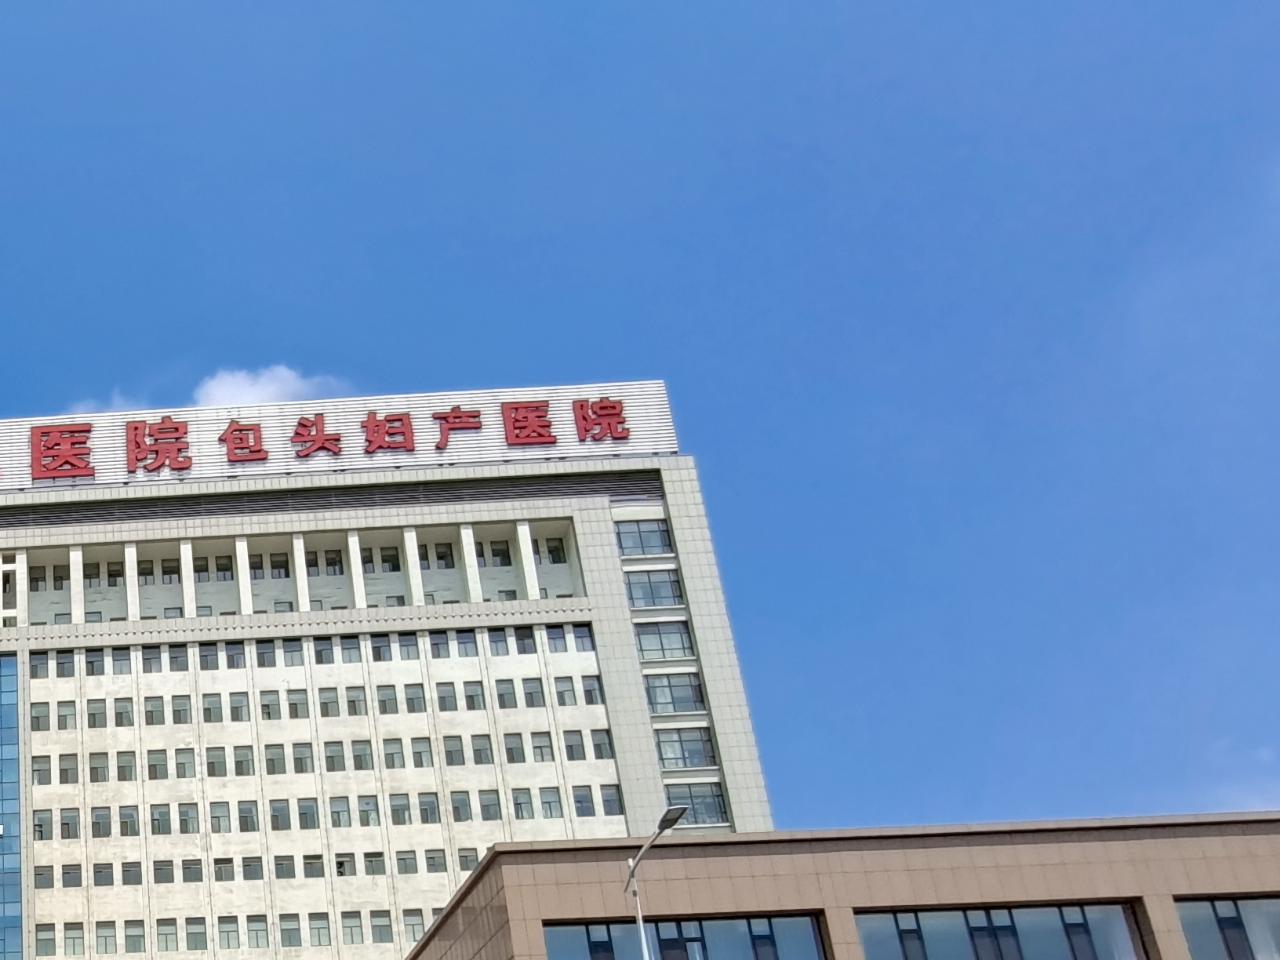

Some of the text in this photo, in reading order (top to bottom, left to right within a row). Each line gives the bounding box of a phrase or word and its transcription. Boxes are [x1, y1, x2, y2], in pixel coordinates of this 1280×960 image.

[219, 398, 631, 462] 包头妇产医院
